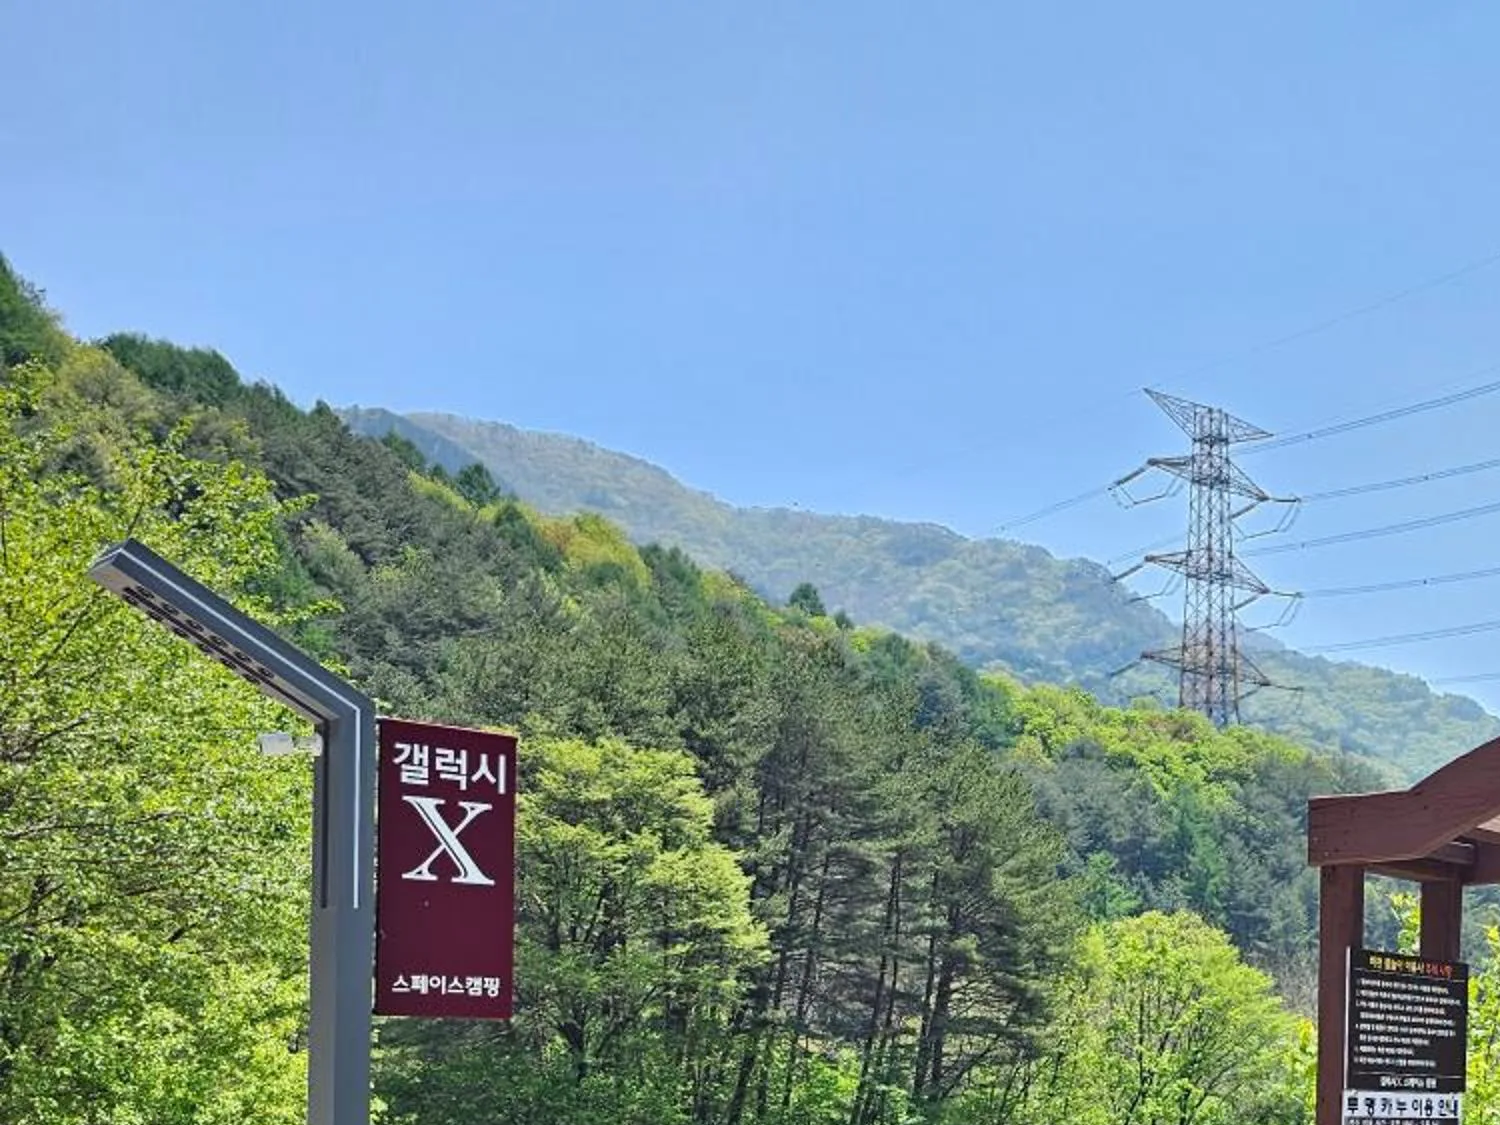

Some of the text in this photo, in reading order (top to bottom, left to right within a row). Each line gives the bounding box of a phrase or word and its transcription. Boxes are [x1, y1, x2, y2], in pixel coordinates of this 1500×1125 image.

[393, 742, 506, 794] 갤럭시
[401, 795, 496, 886] X
[391, 974, 501, 997] 스페이스캠핑
